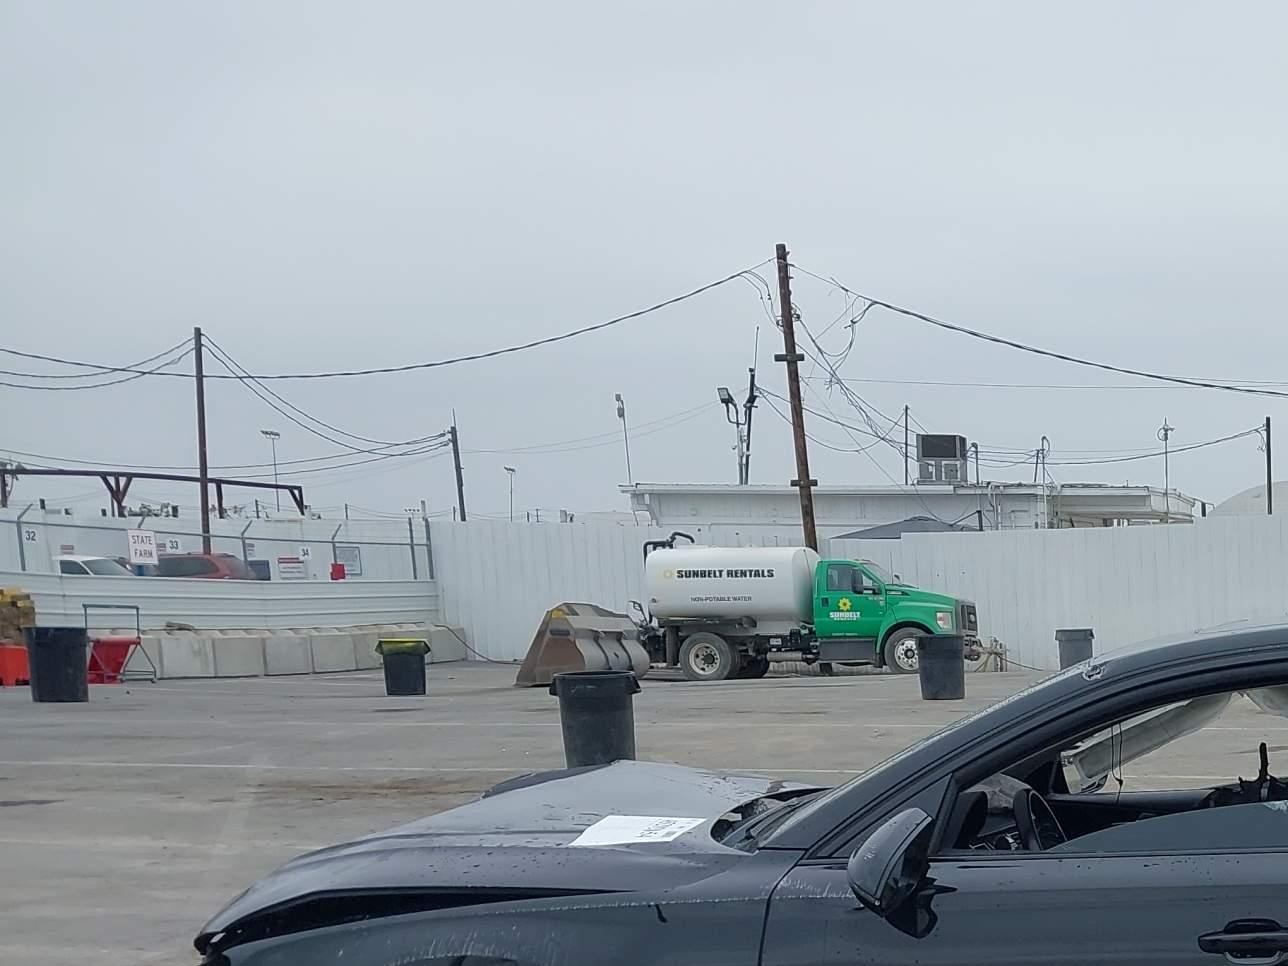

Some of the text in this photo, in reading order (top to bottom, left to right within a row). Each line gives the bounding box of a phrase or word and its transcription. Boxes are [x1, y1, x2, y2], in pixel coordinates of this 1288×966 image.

[25, 530, 36, 541] 32
[131, 535, 153, 545] STATE
[169, 539, 179, 550] 33
[134, 549, 153, 559] FARM
[301, 548, 309, 556] 34
[676, 568, 775, 579] SUNBELT RENTALS
